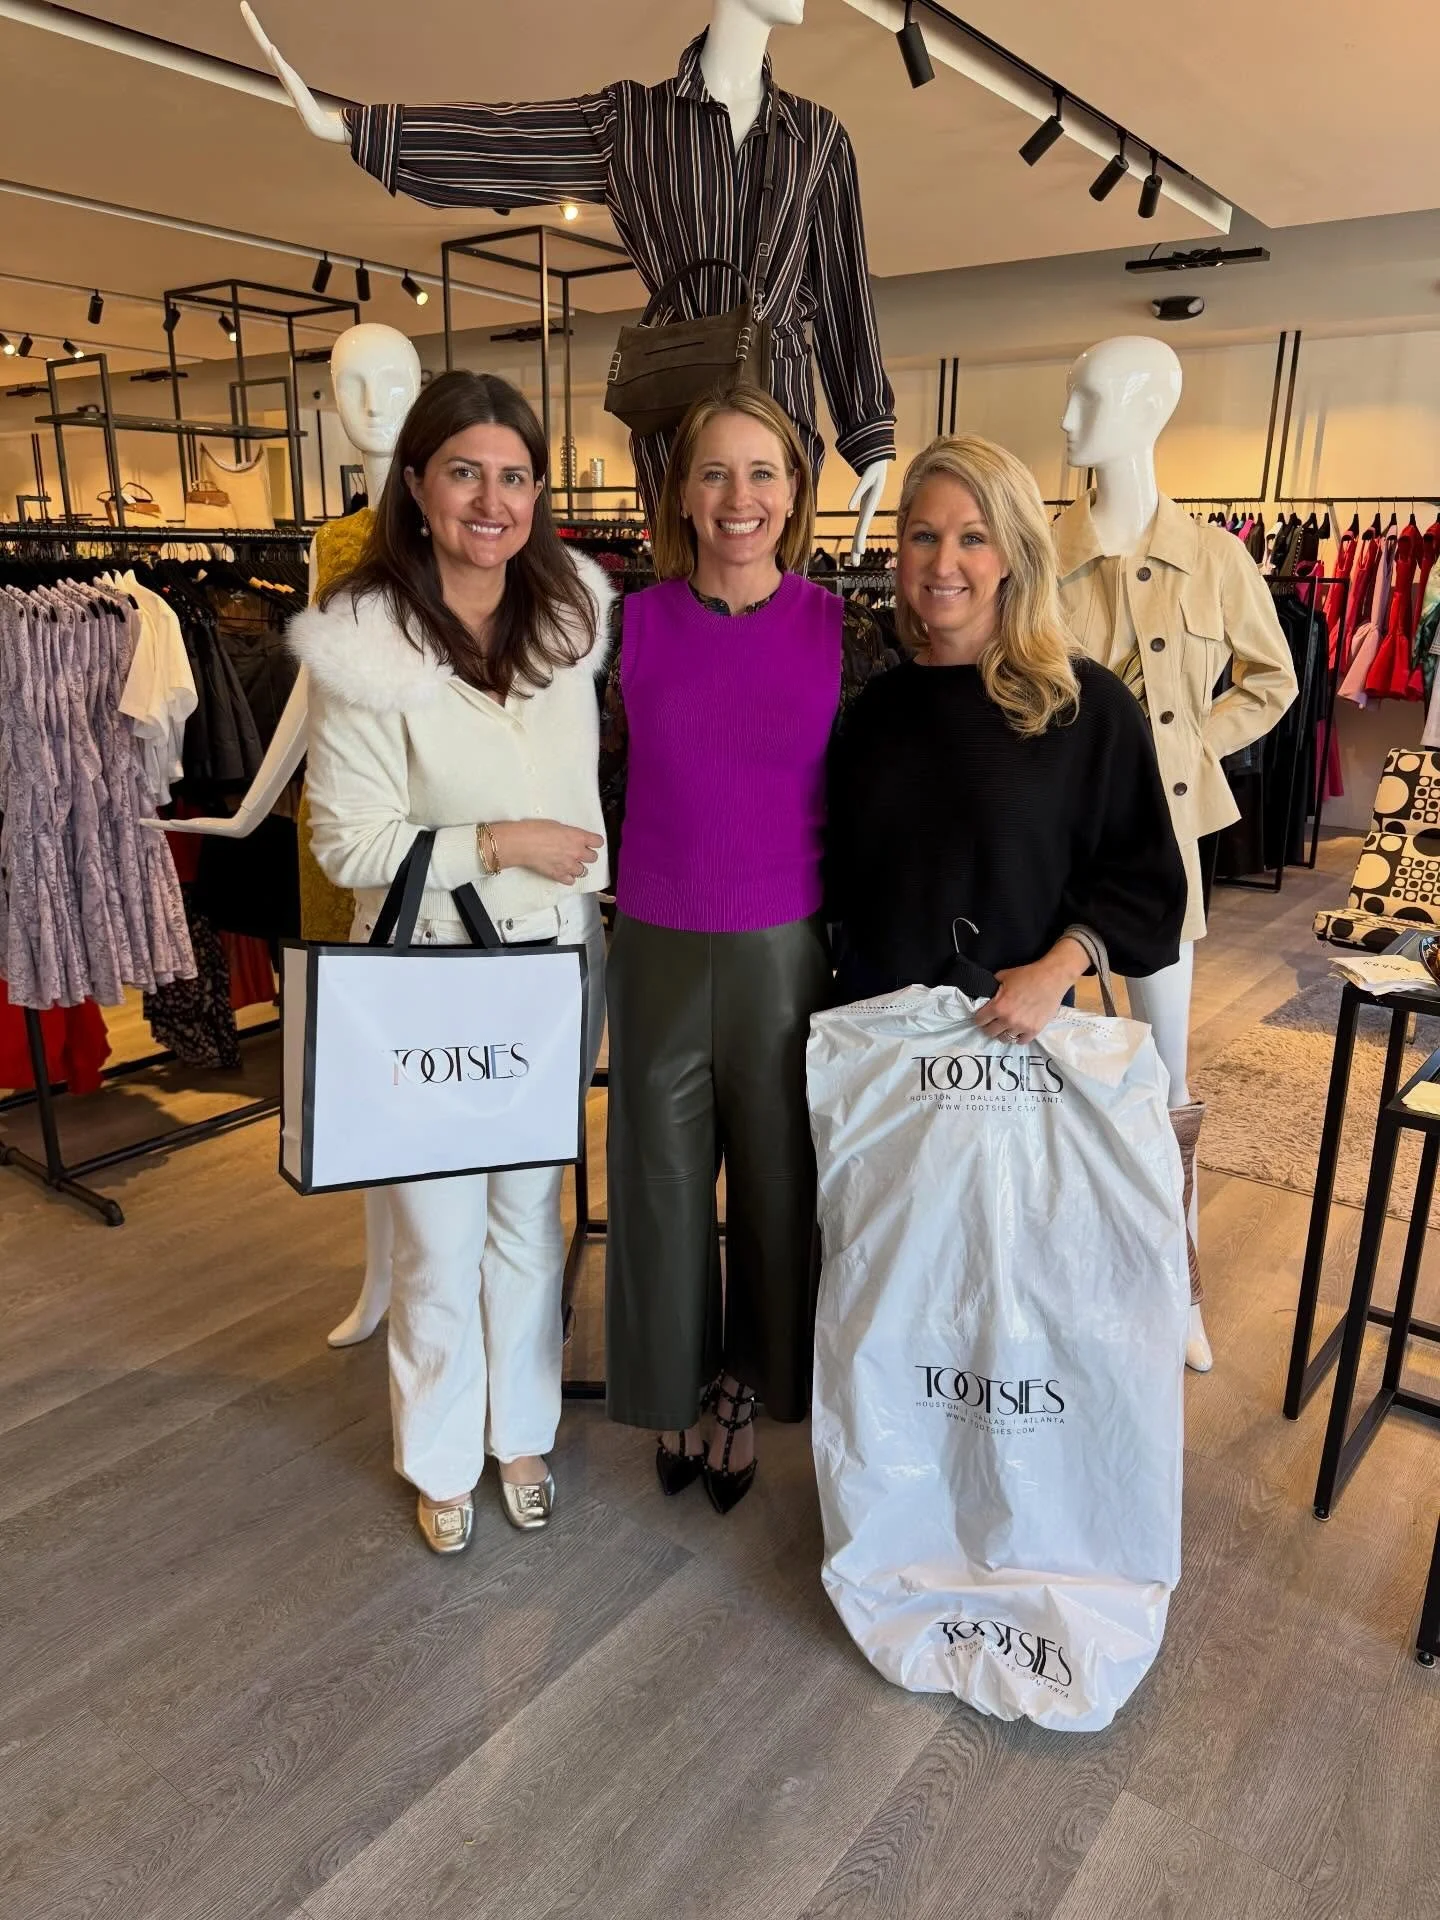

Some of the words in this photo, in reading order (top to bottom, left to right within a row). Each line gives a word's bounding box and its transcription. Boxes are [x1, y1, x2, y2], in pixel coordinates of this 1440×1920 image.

[391, 1042, 530, 1086] TOOTSIES
[911, 1054, 1064, 1094] TOOTSIES
[910, 1094, 951, 1102] HOUSTON
[970, 1094, 1006, 1102] DALLAS
[915, 1365, 1065, 1416] TOOTSIES
[915, 1401, 959, 1411] HOUSTON
[974, 1411, 1005, 1425] DALLAS
[1023, 1416, 1065, 1425] ATLANTA
[936, 1620, 1072, 1687] TOOTSIES
